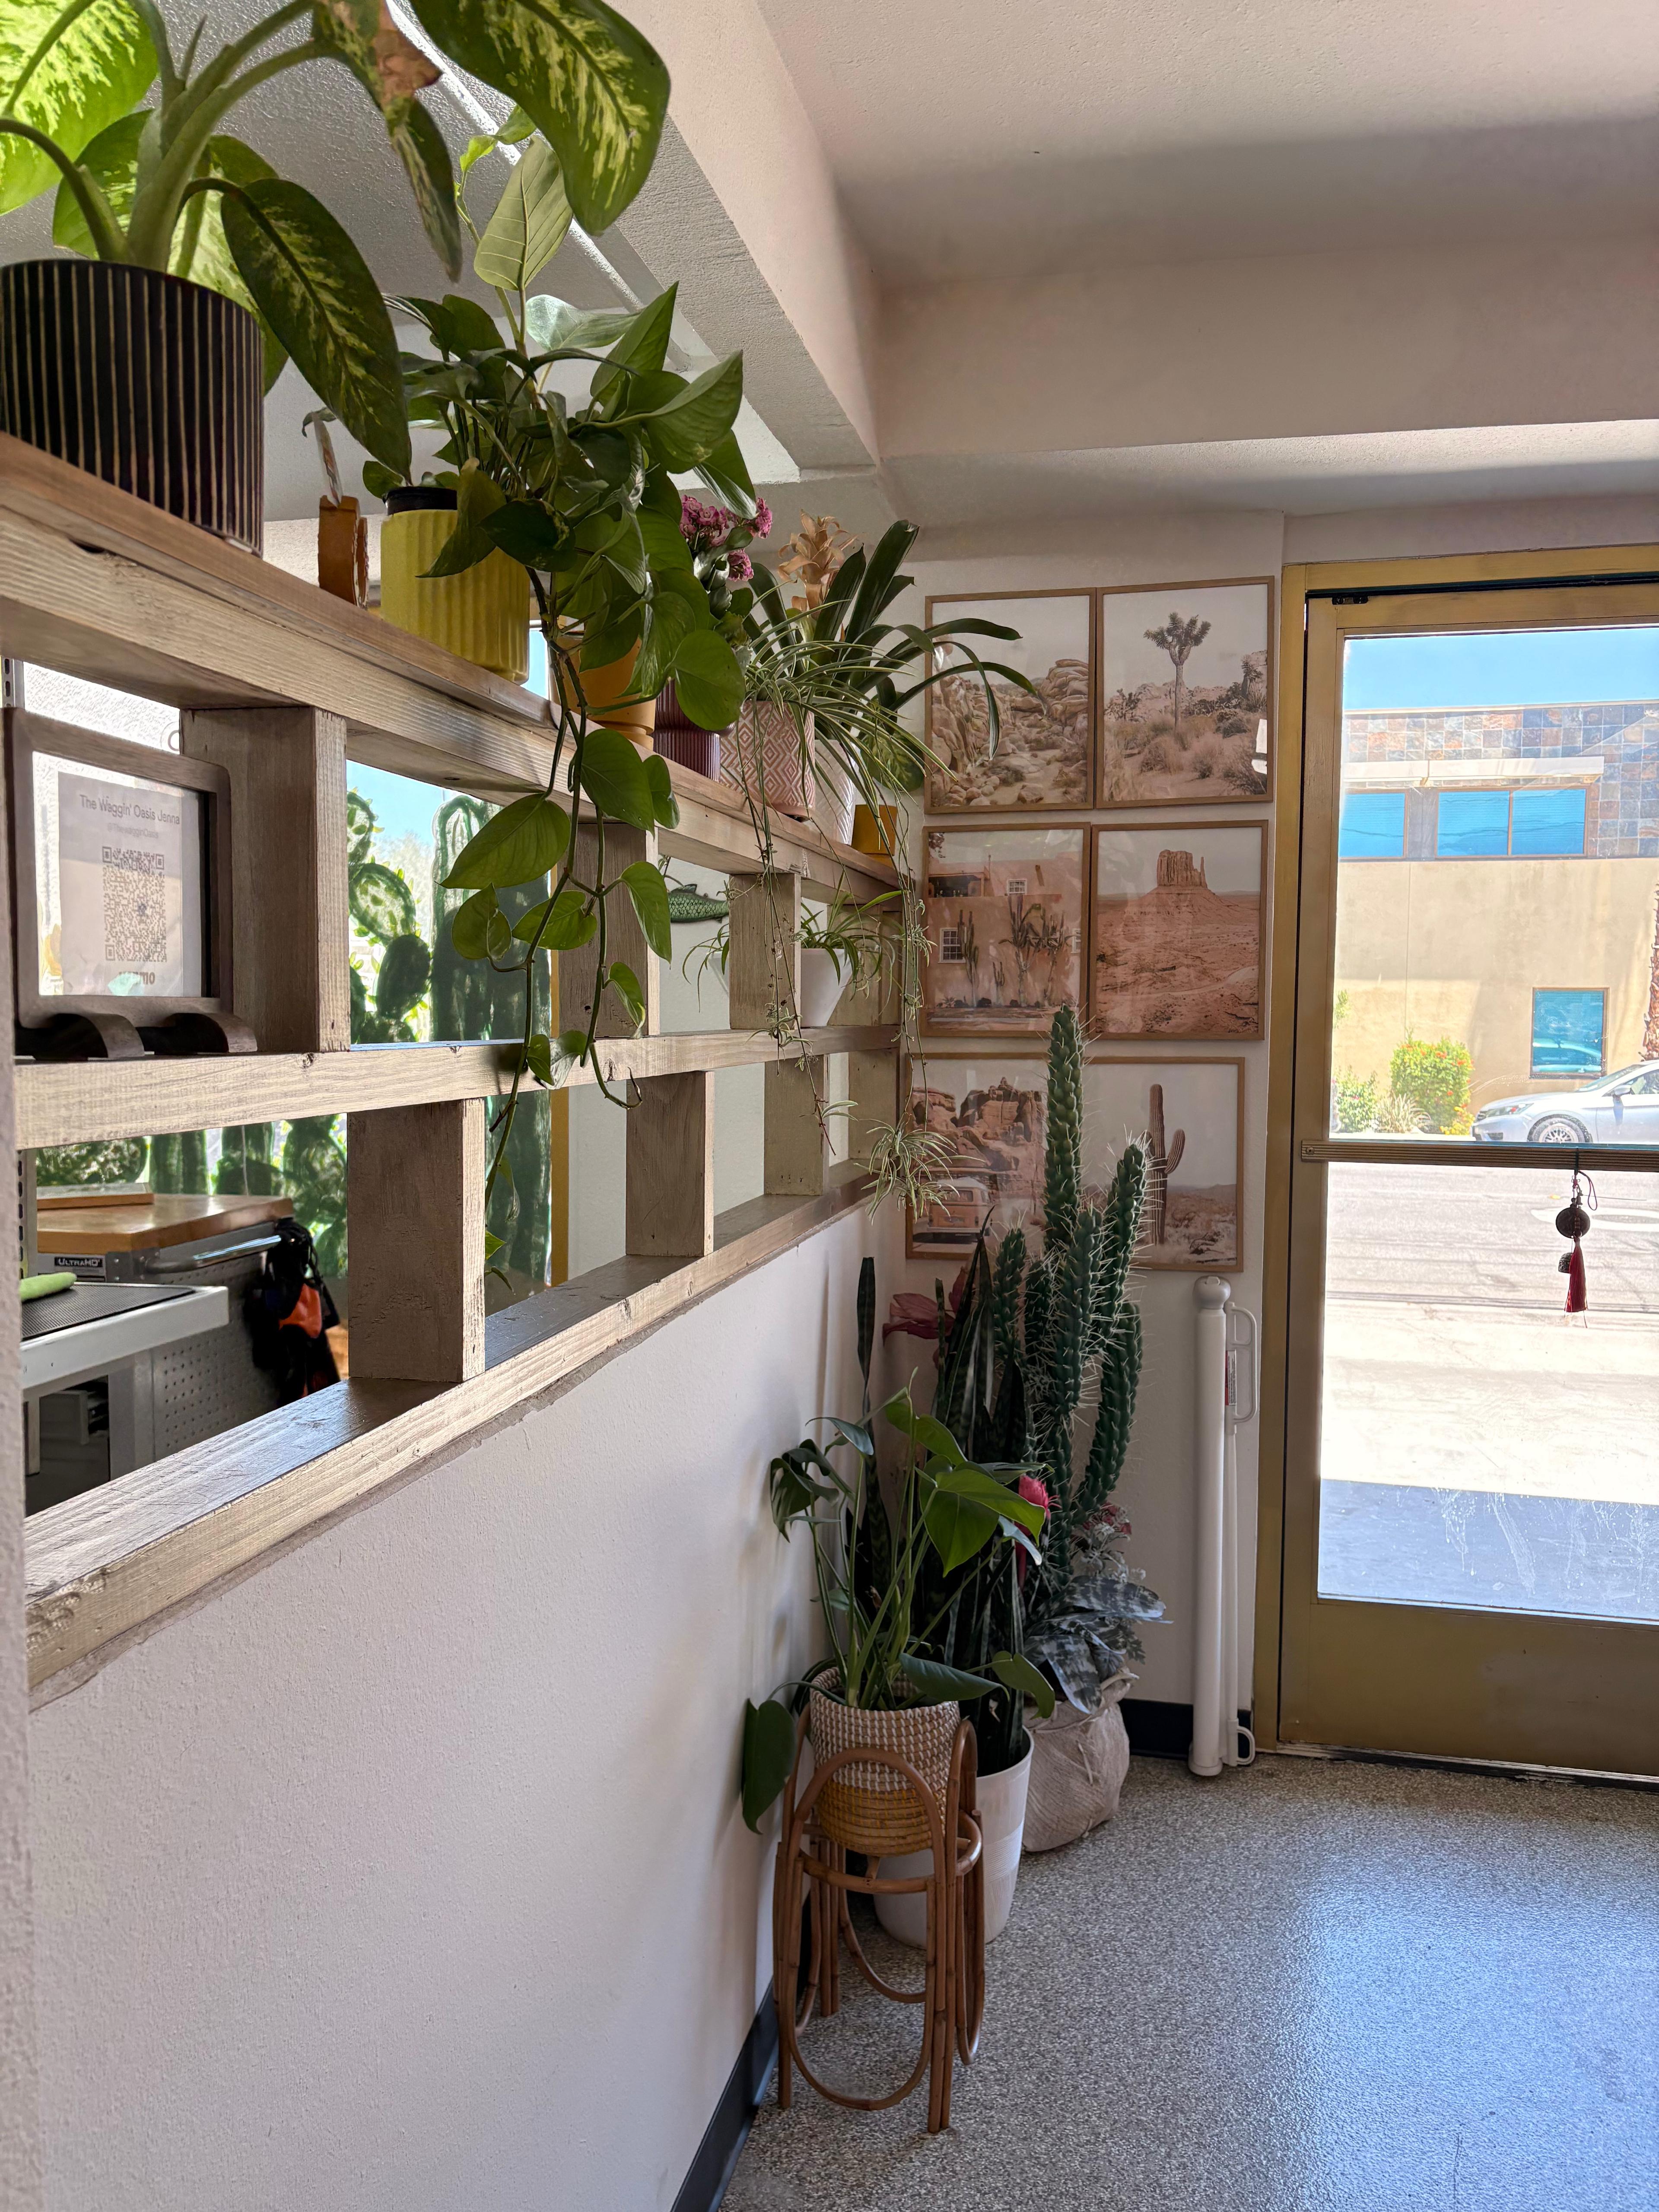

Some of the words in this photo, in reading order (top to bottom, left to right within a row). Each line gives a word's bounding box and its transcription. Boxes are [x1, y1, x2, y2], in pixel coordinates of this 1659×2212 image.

[79, 794, 97, 810] The
[133, 805, 156, 820] Oasis
[157, 809, 180, 824] Jenna
